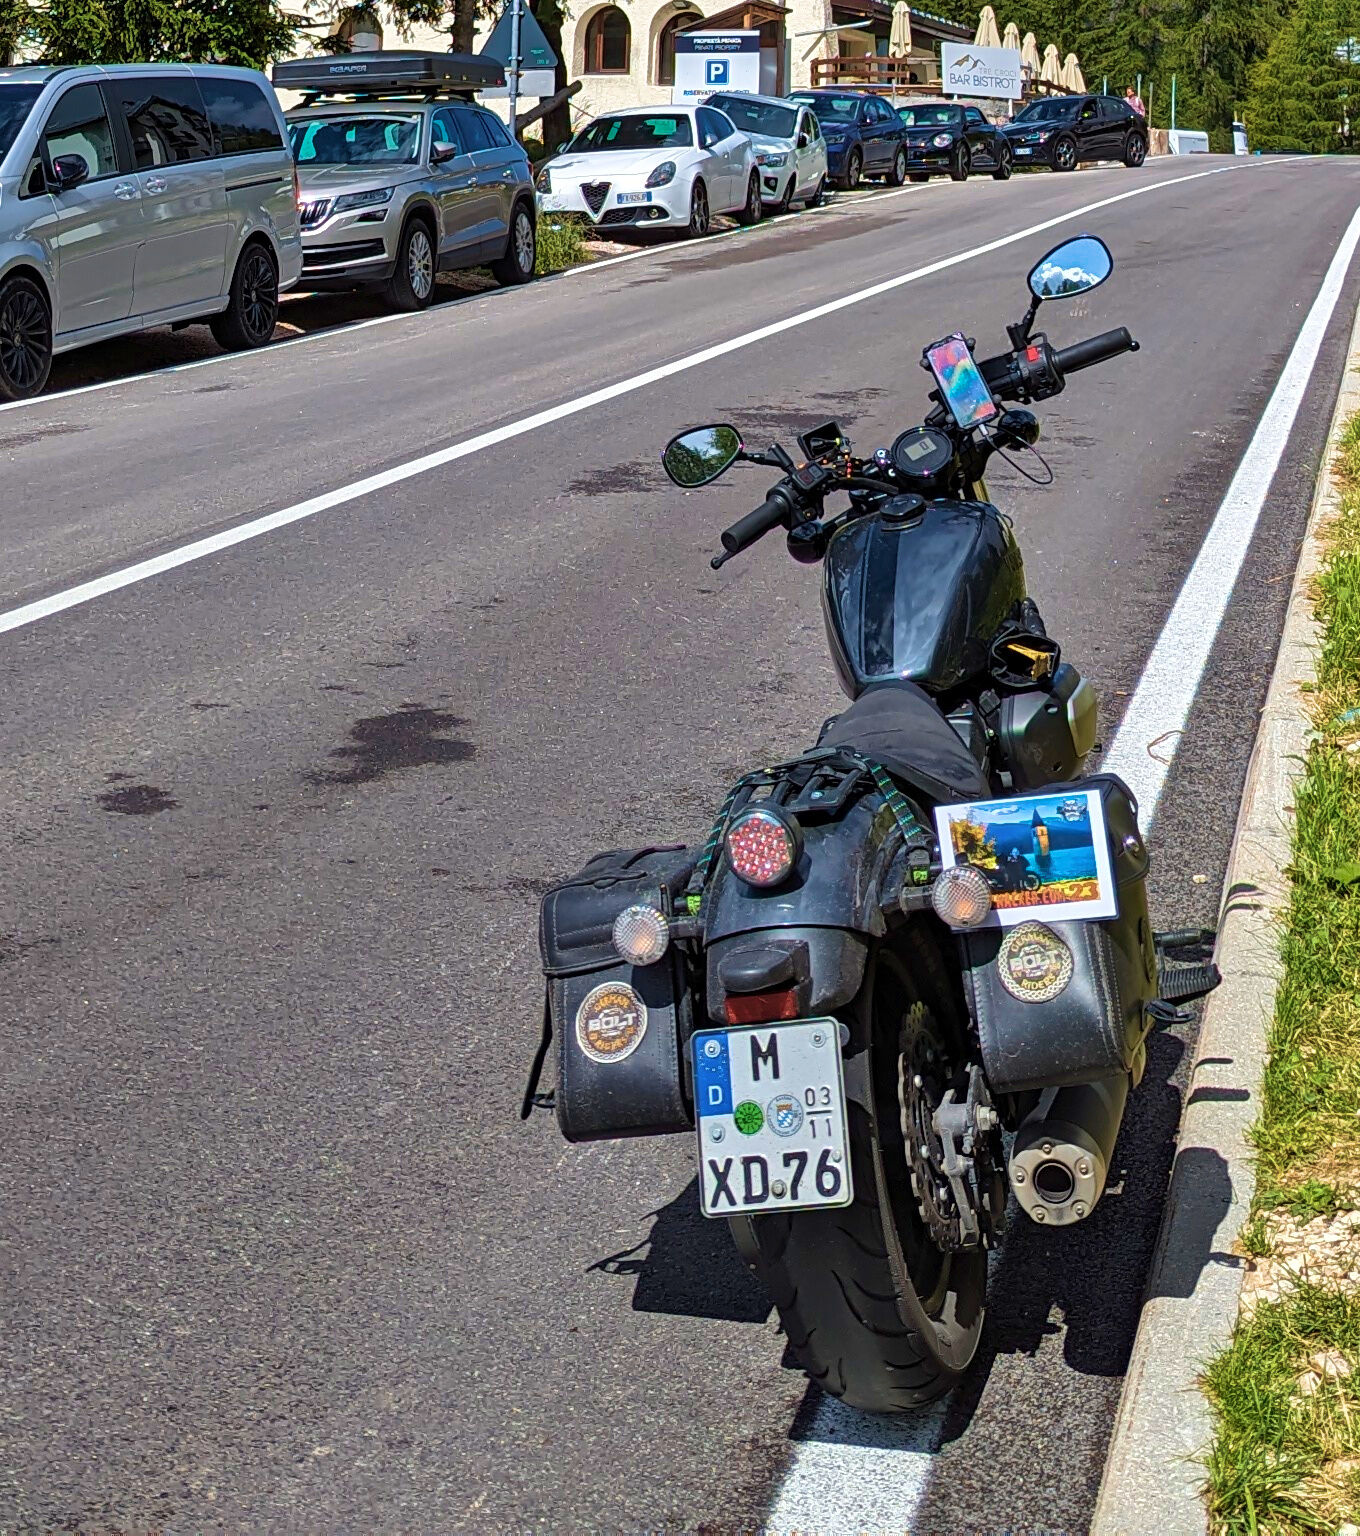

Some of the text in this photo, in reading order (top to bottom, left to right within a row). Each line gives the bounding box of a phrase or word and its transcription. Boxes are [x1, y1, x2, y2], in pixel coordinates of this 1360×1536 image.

[710, 63, 724, 82] P
[949, 73, 1017, 89] BAR BISTROT
[994, 69, 1017, 78] CROCI
[1009, 949, 1062, 972] BOLT
[1021, 972, 1056, 991] RIDERS
[588, 1012, 638, 1032] BOLT
[750, 1032, 780, 1082] M
[708, 1085, 723, 1105] D
[804, 1086, 831, 1107] 03
[809, 1117, 832, 1139] 11
[708, 1148, 841, 1208] XD 76
